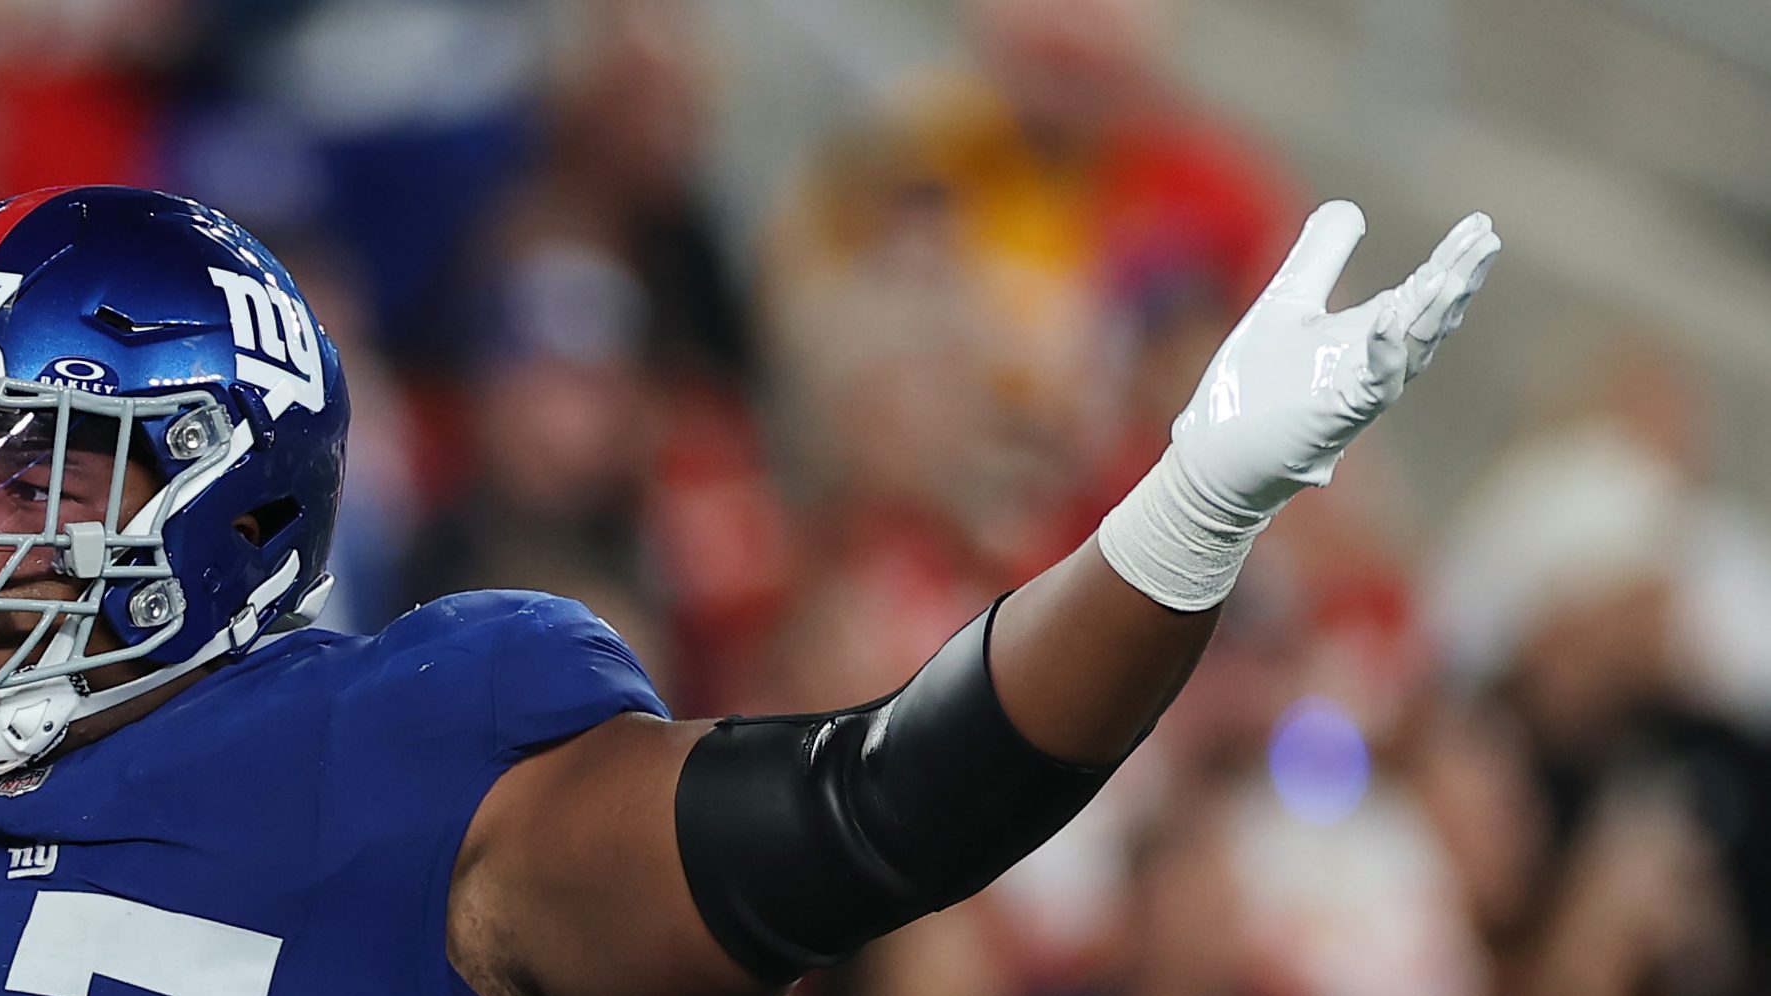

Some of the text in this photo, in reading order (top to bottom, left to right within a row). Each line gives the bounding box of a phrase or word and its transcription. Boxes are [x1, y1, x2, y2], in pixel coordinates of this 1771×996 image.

[207, 266, 326, 422] ny
[40, 376, 116, 394] OAKLEY
[7, 844, 58, 880] ny
